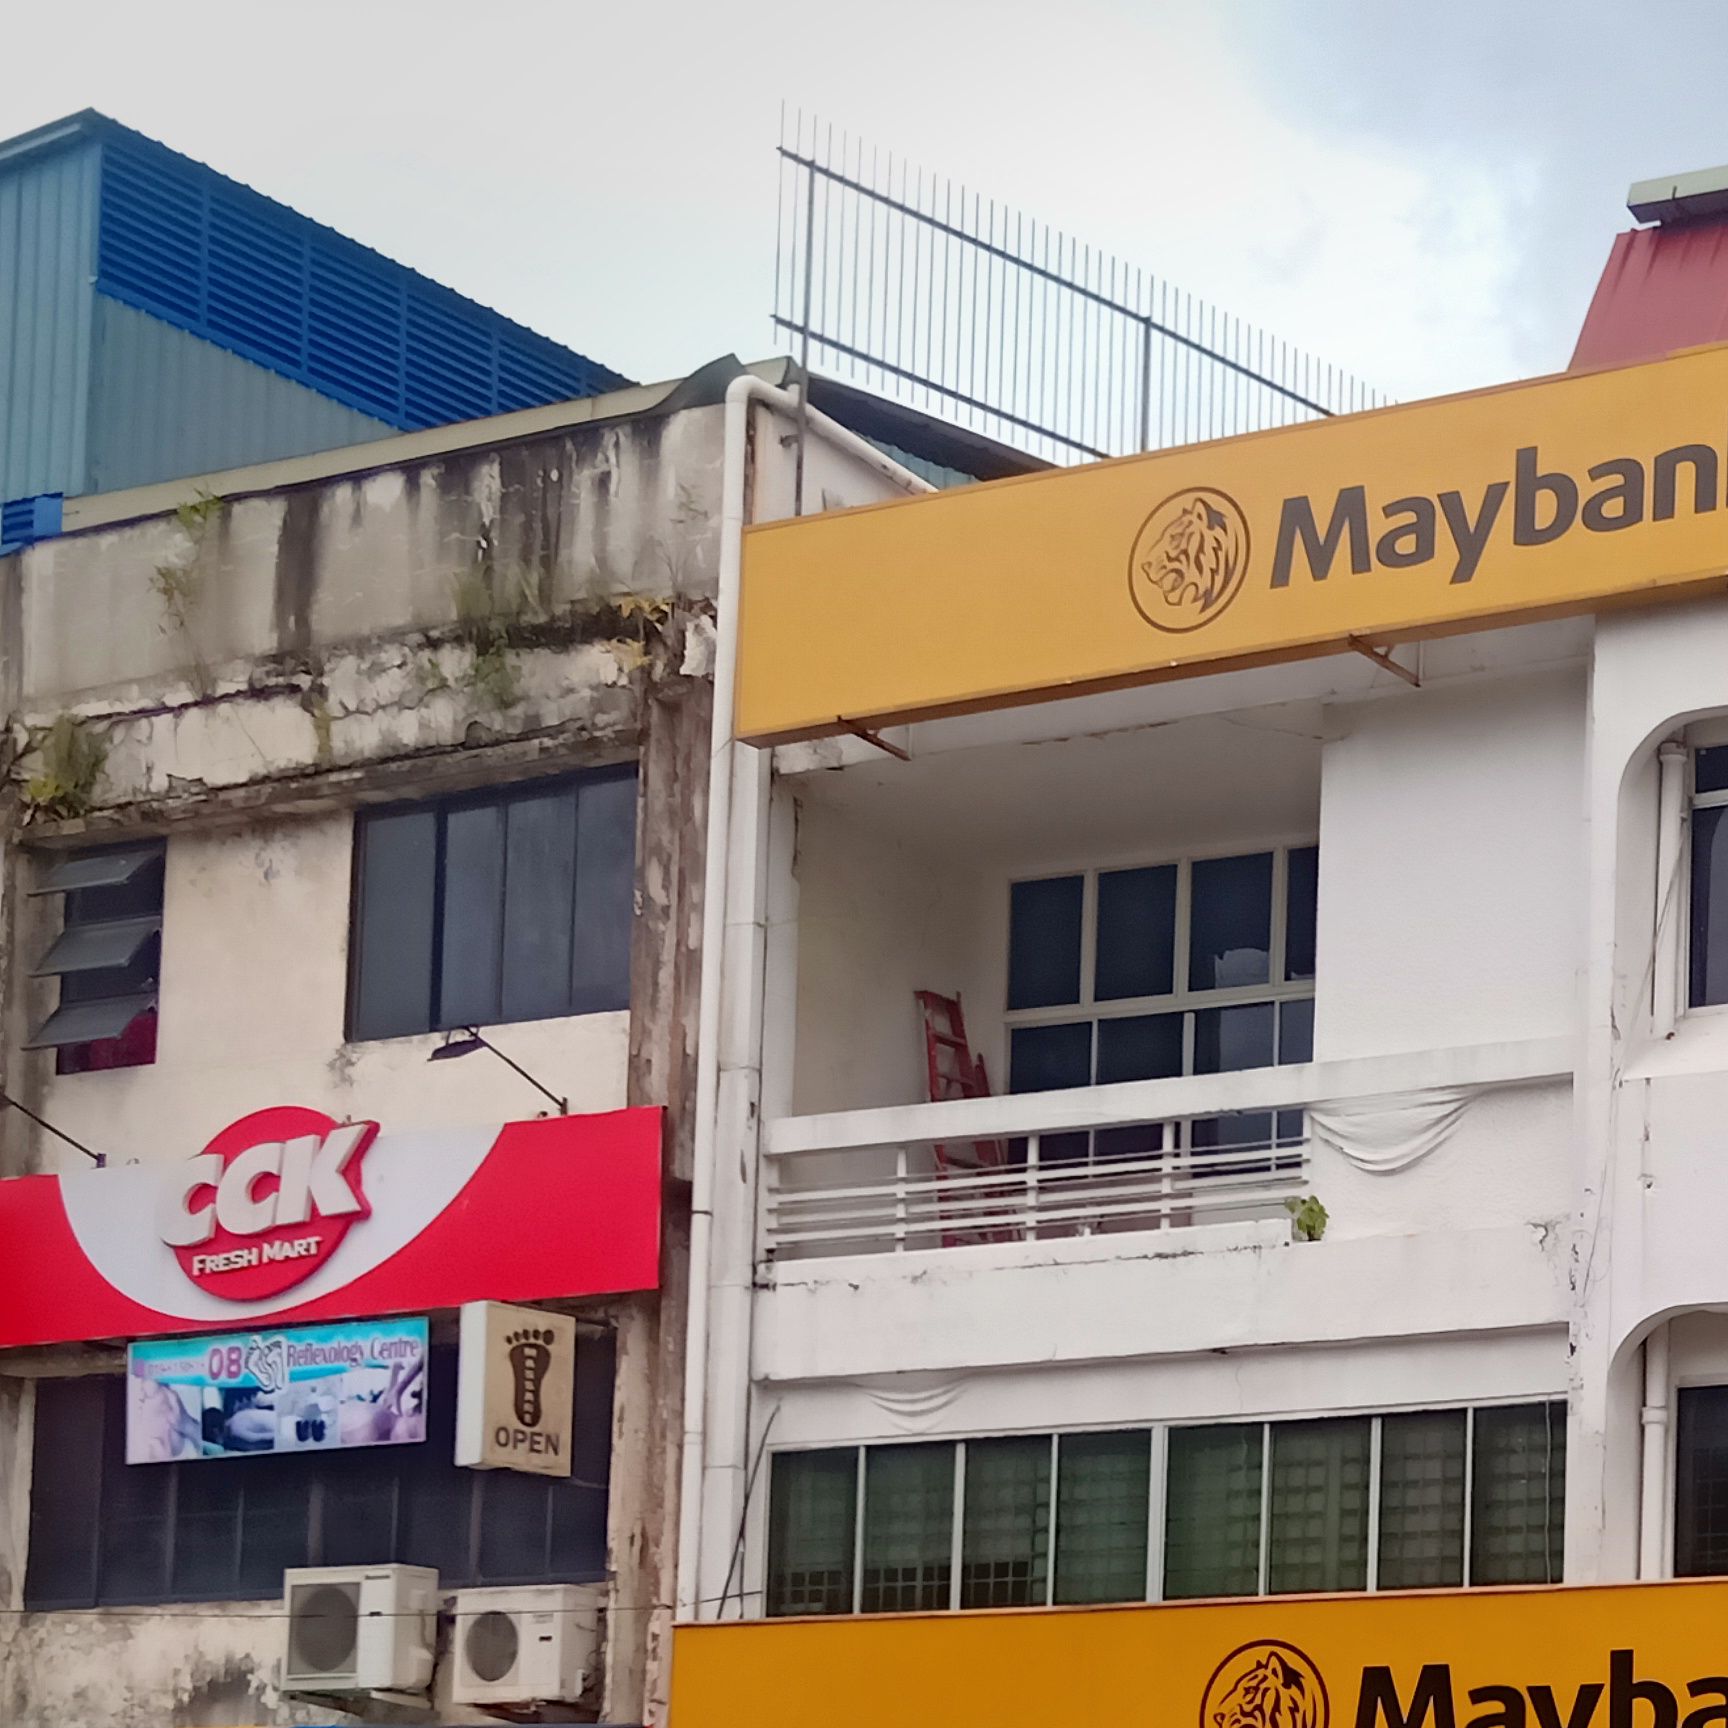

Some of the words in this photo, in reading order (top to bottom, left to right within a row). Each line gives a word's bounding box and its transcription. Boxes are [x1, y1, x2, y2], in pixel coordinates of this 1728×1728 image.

[162, 1121, 375, 1247] CCK
[192, 1247, 258, 1276] FRESH
[261, 1236, 322, 1263] MART
[287, 1341, 363, 1368] Reflexology
[371, 1337, 419, 1360] Centre
[495, 1426, 560, 1456] OPEN
